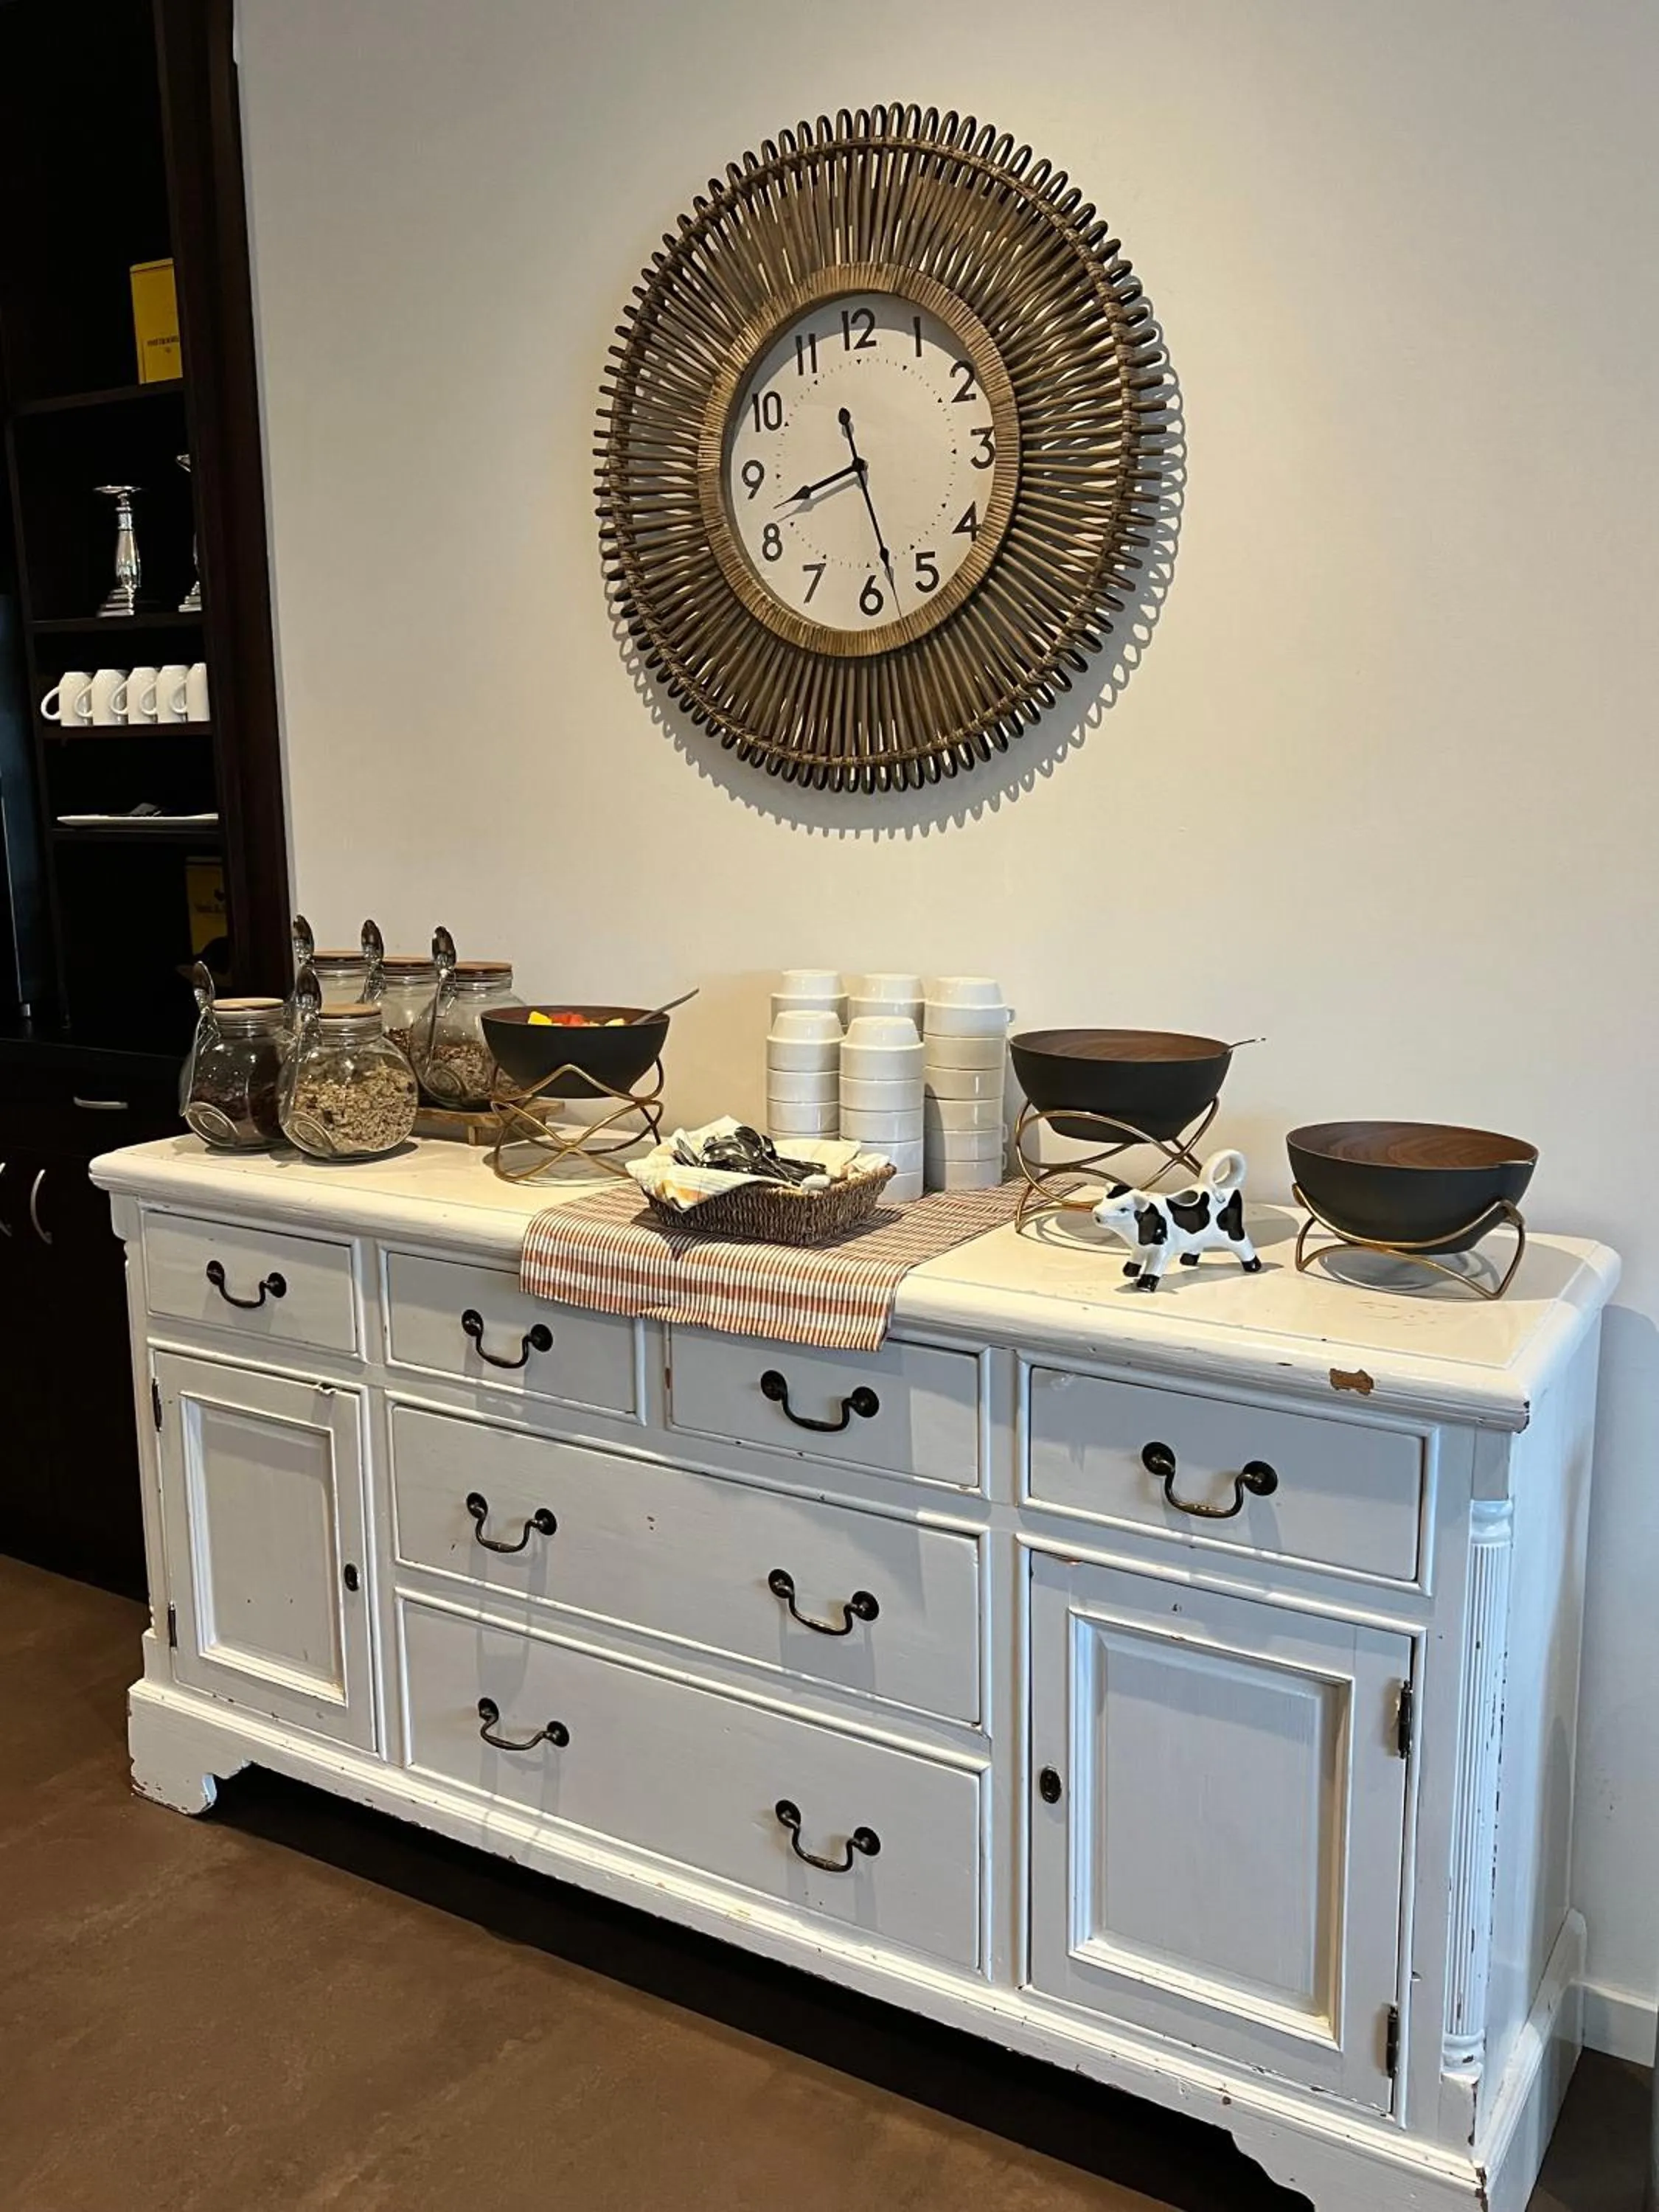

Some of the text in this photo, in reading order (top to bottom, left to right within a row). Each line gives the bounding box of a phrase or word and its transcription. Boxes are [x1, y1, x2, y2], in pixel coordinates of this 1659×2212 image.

[841, 307, 877, 352] 12
[912, 315, 922, 358] 1
[794, 333, 817, 375] 11
[949, 360, 978, 403] 2
[751, 390, 783, 433] 10
[970, 425, 996, 470] 3
[741, 459, 765, 500] 9
[761, 522, 784, 562] 8
[951, 501, 981, 543] 4
[801, 563, 827, 604] 7
[914, 550, 940, 594] 5
[858, 574, 885, 616] 6
